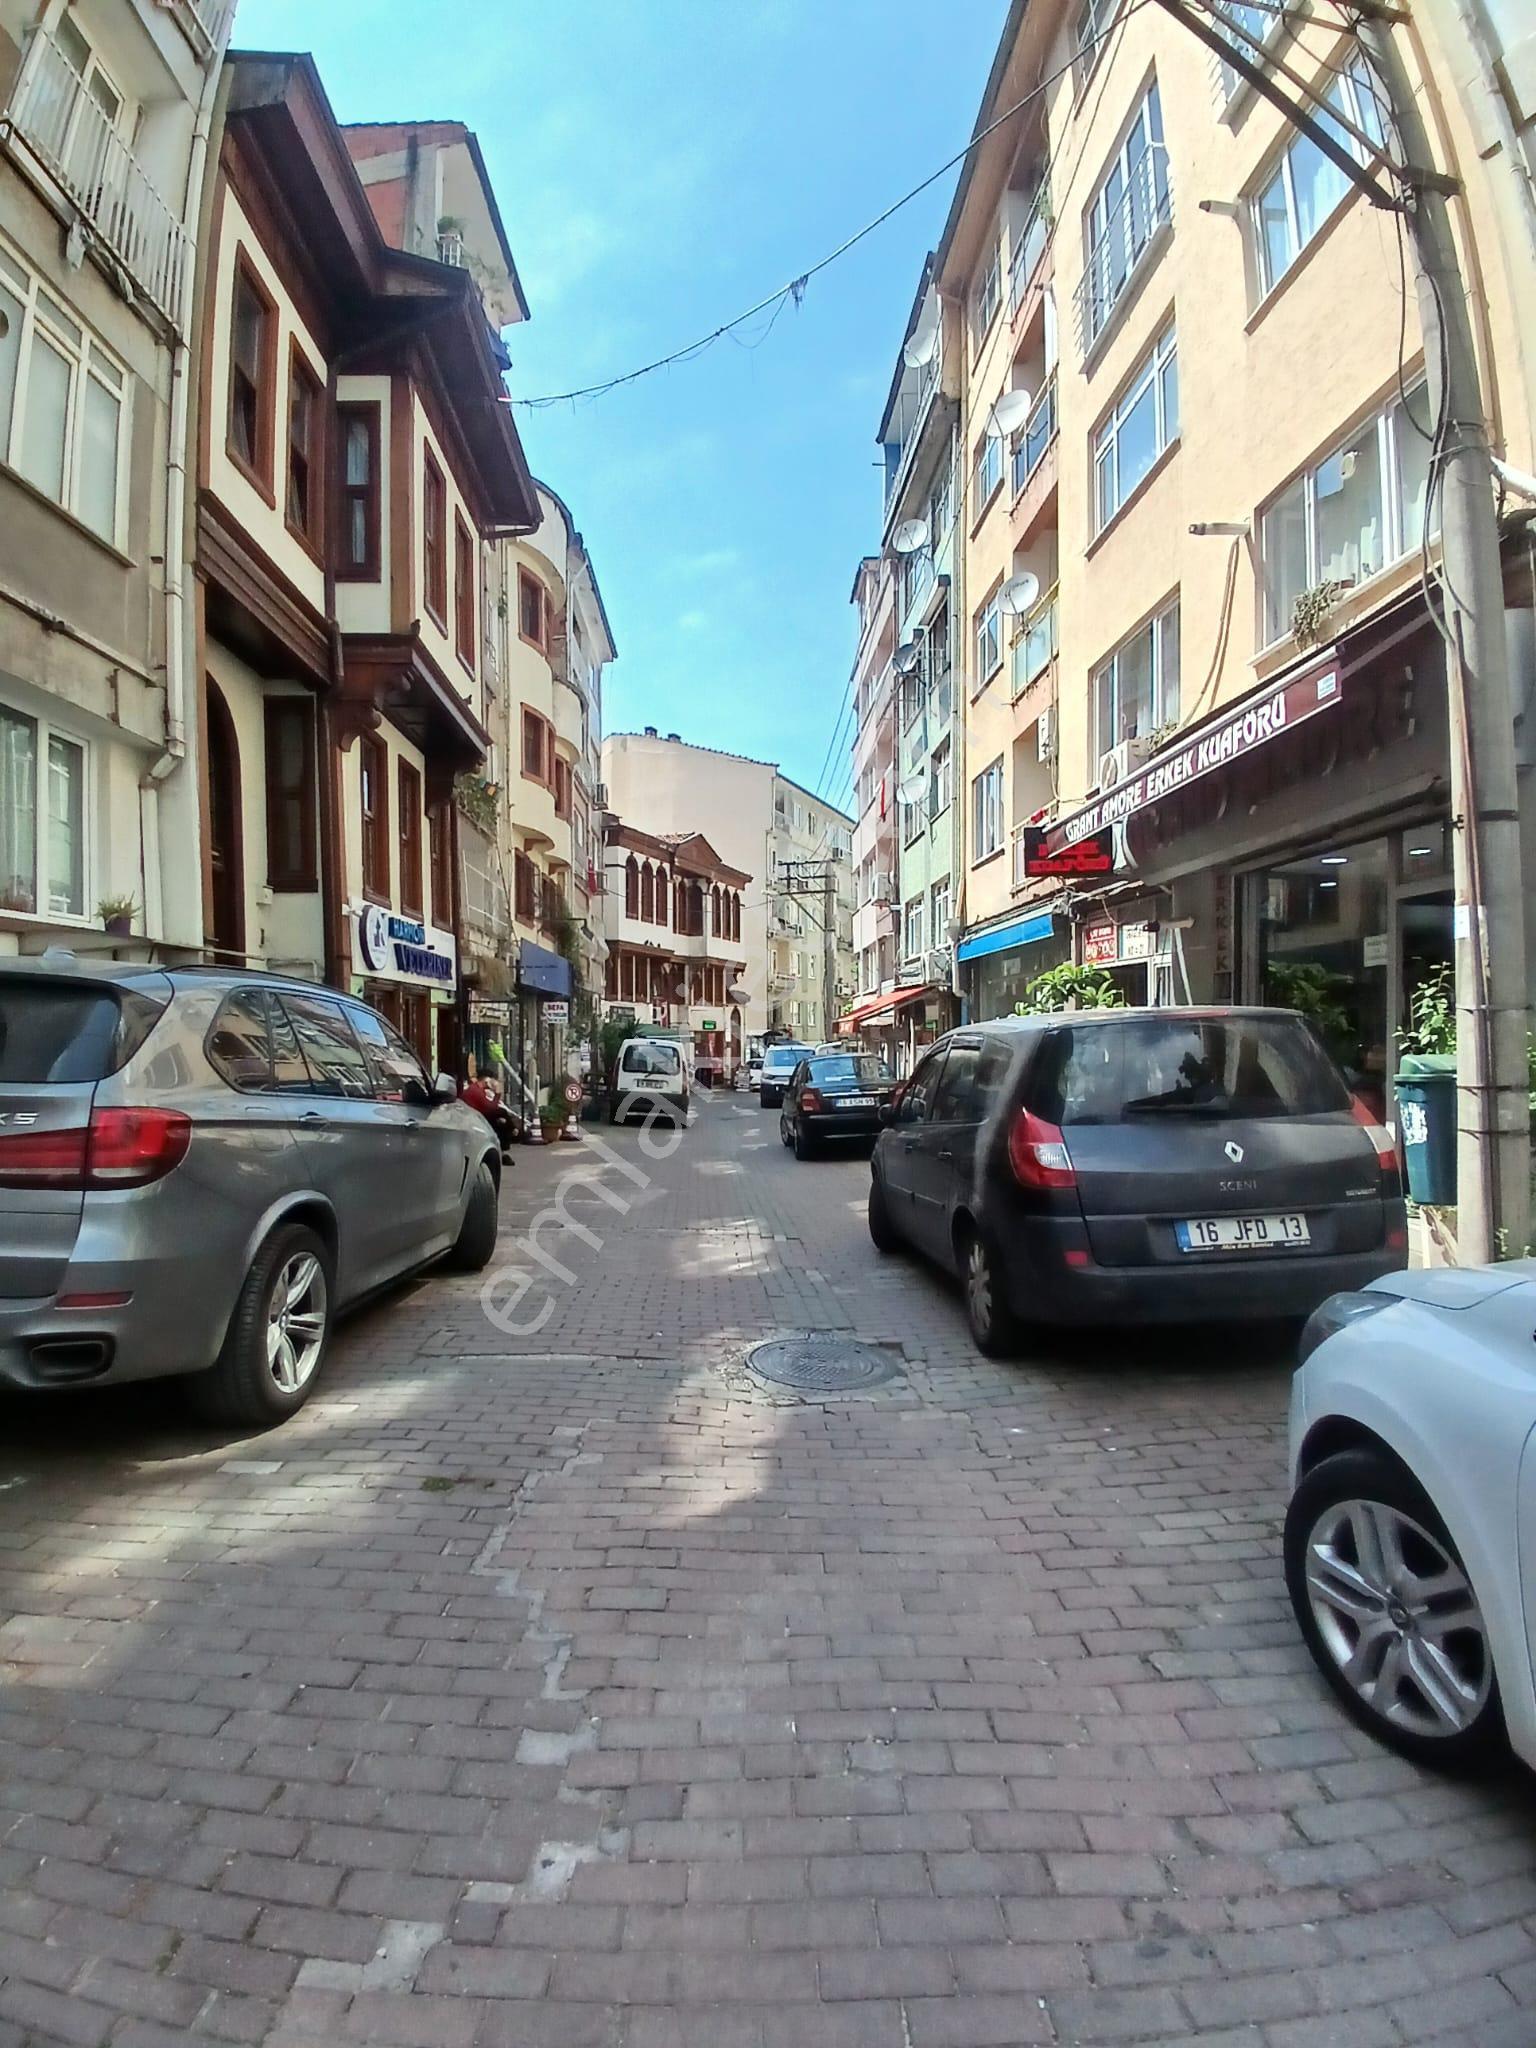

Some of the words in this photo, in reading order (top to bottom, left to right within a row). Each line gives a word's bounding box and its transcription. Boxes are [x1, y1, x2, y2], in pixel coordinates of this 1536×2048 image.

[1066, 808, 1099, 842] GRANT
[1101, 780, 1142, 824] AMORE
[1147, 753, 1195, 796] ERKEK
[1196, 1221, 1219, 1243] 16
[1234, 1218, 1268, 1241] JFD
[1280, 1217, 1302, 1240] 13
